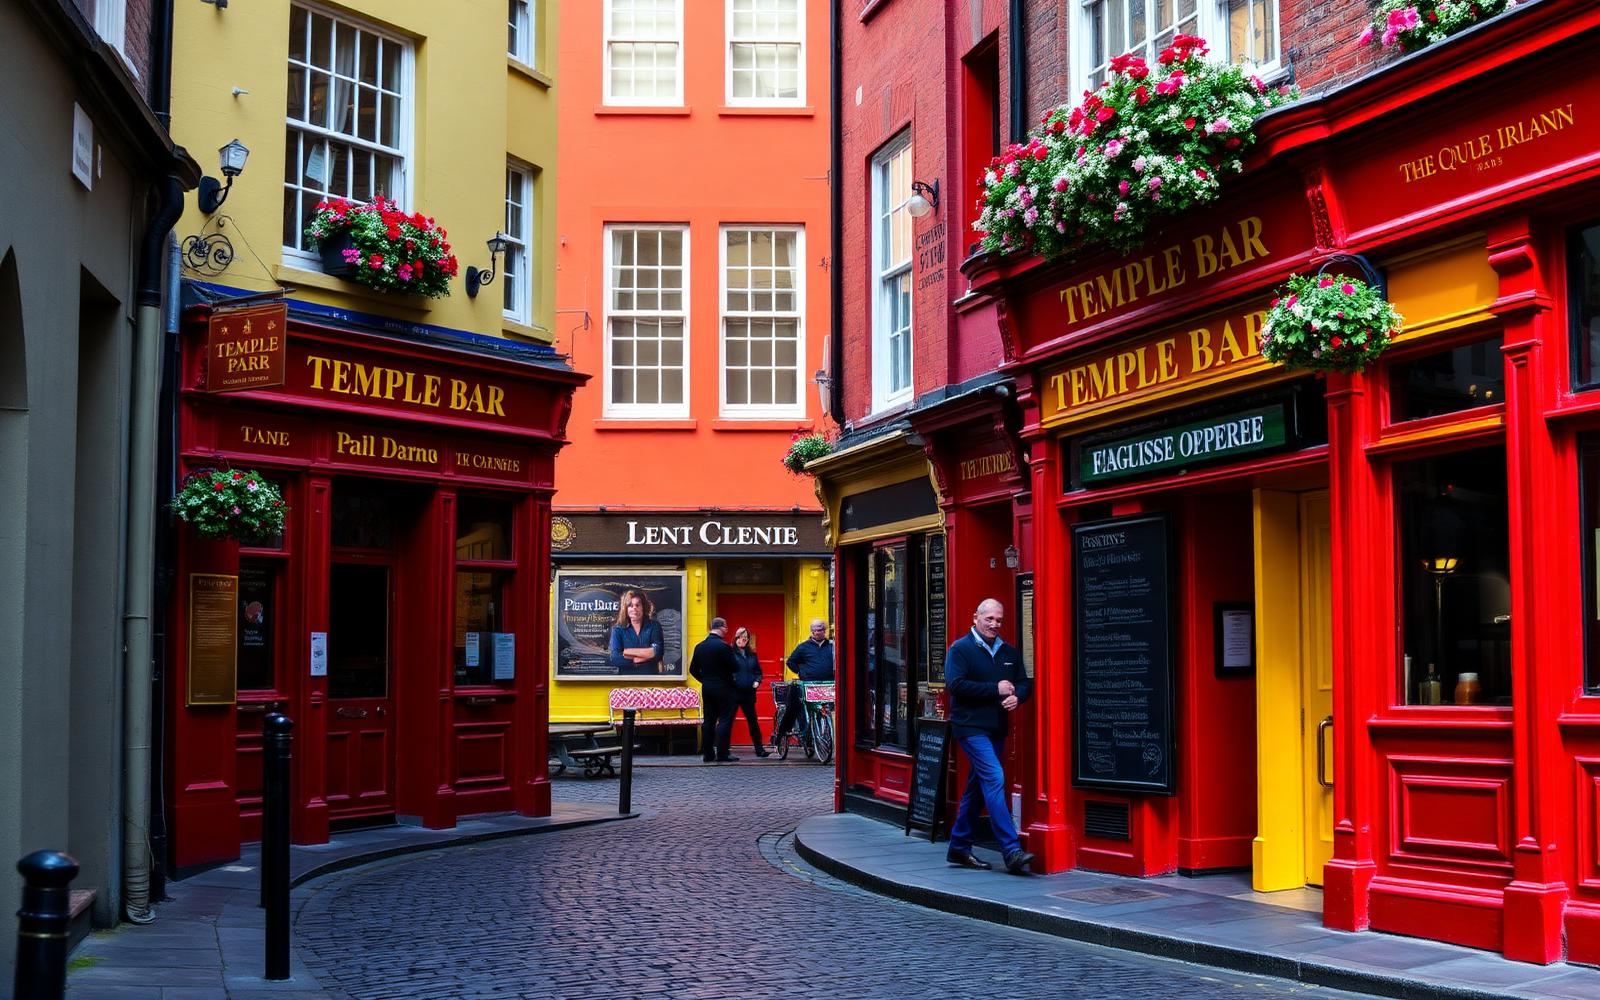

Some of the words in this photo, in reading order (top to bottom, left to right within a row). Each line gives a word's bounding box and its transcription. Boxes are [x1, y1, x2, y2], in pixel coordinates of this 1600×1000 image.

[1399, 155, 1437, 183] THE
[1060, 244, 1186, 325] TEMPLE
[1192, 216, 1270, 279] BAR
[215, 336, 279, 358] TEMPLE
[306, 355, 441, 408] TEMPLE
[449, 378, 506, 416] BAR
[1051, 338, 1179, 411] TEMPLE
[241, 426, 290, 446] TANE
[626, 521, 693, 545] LENT
[699, 520, 798, 545] CLENIE
